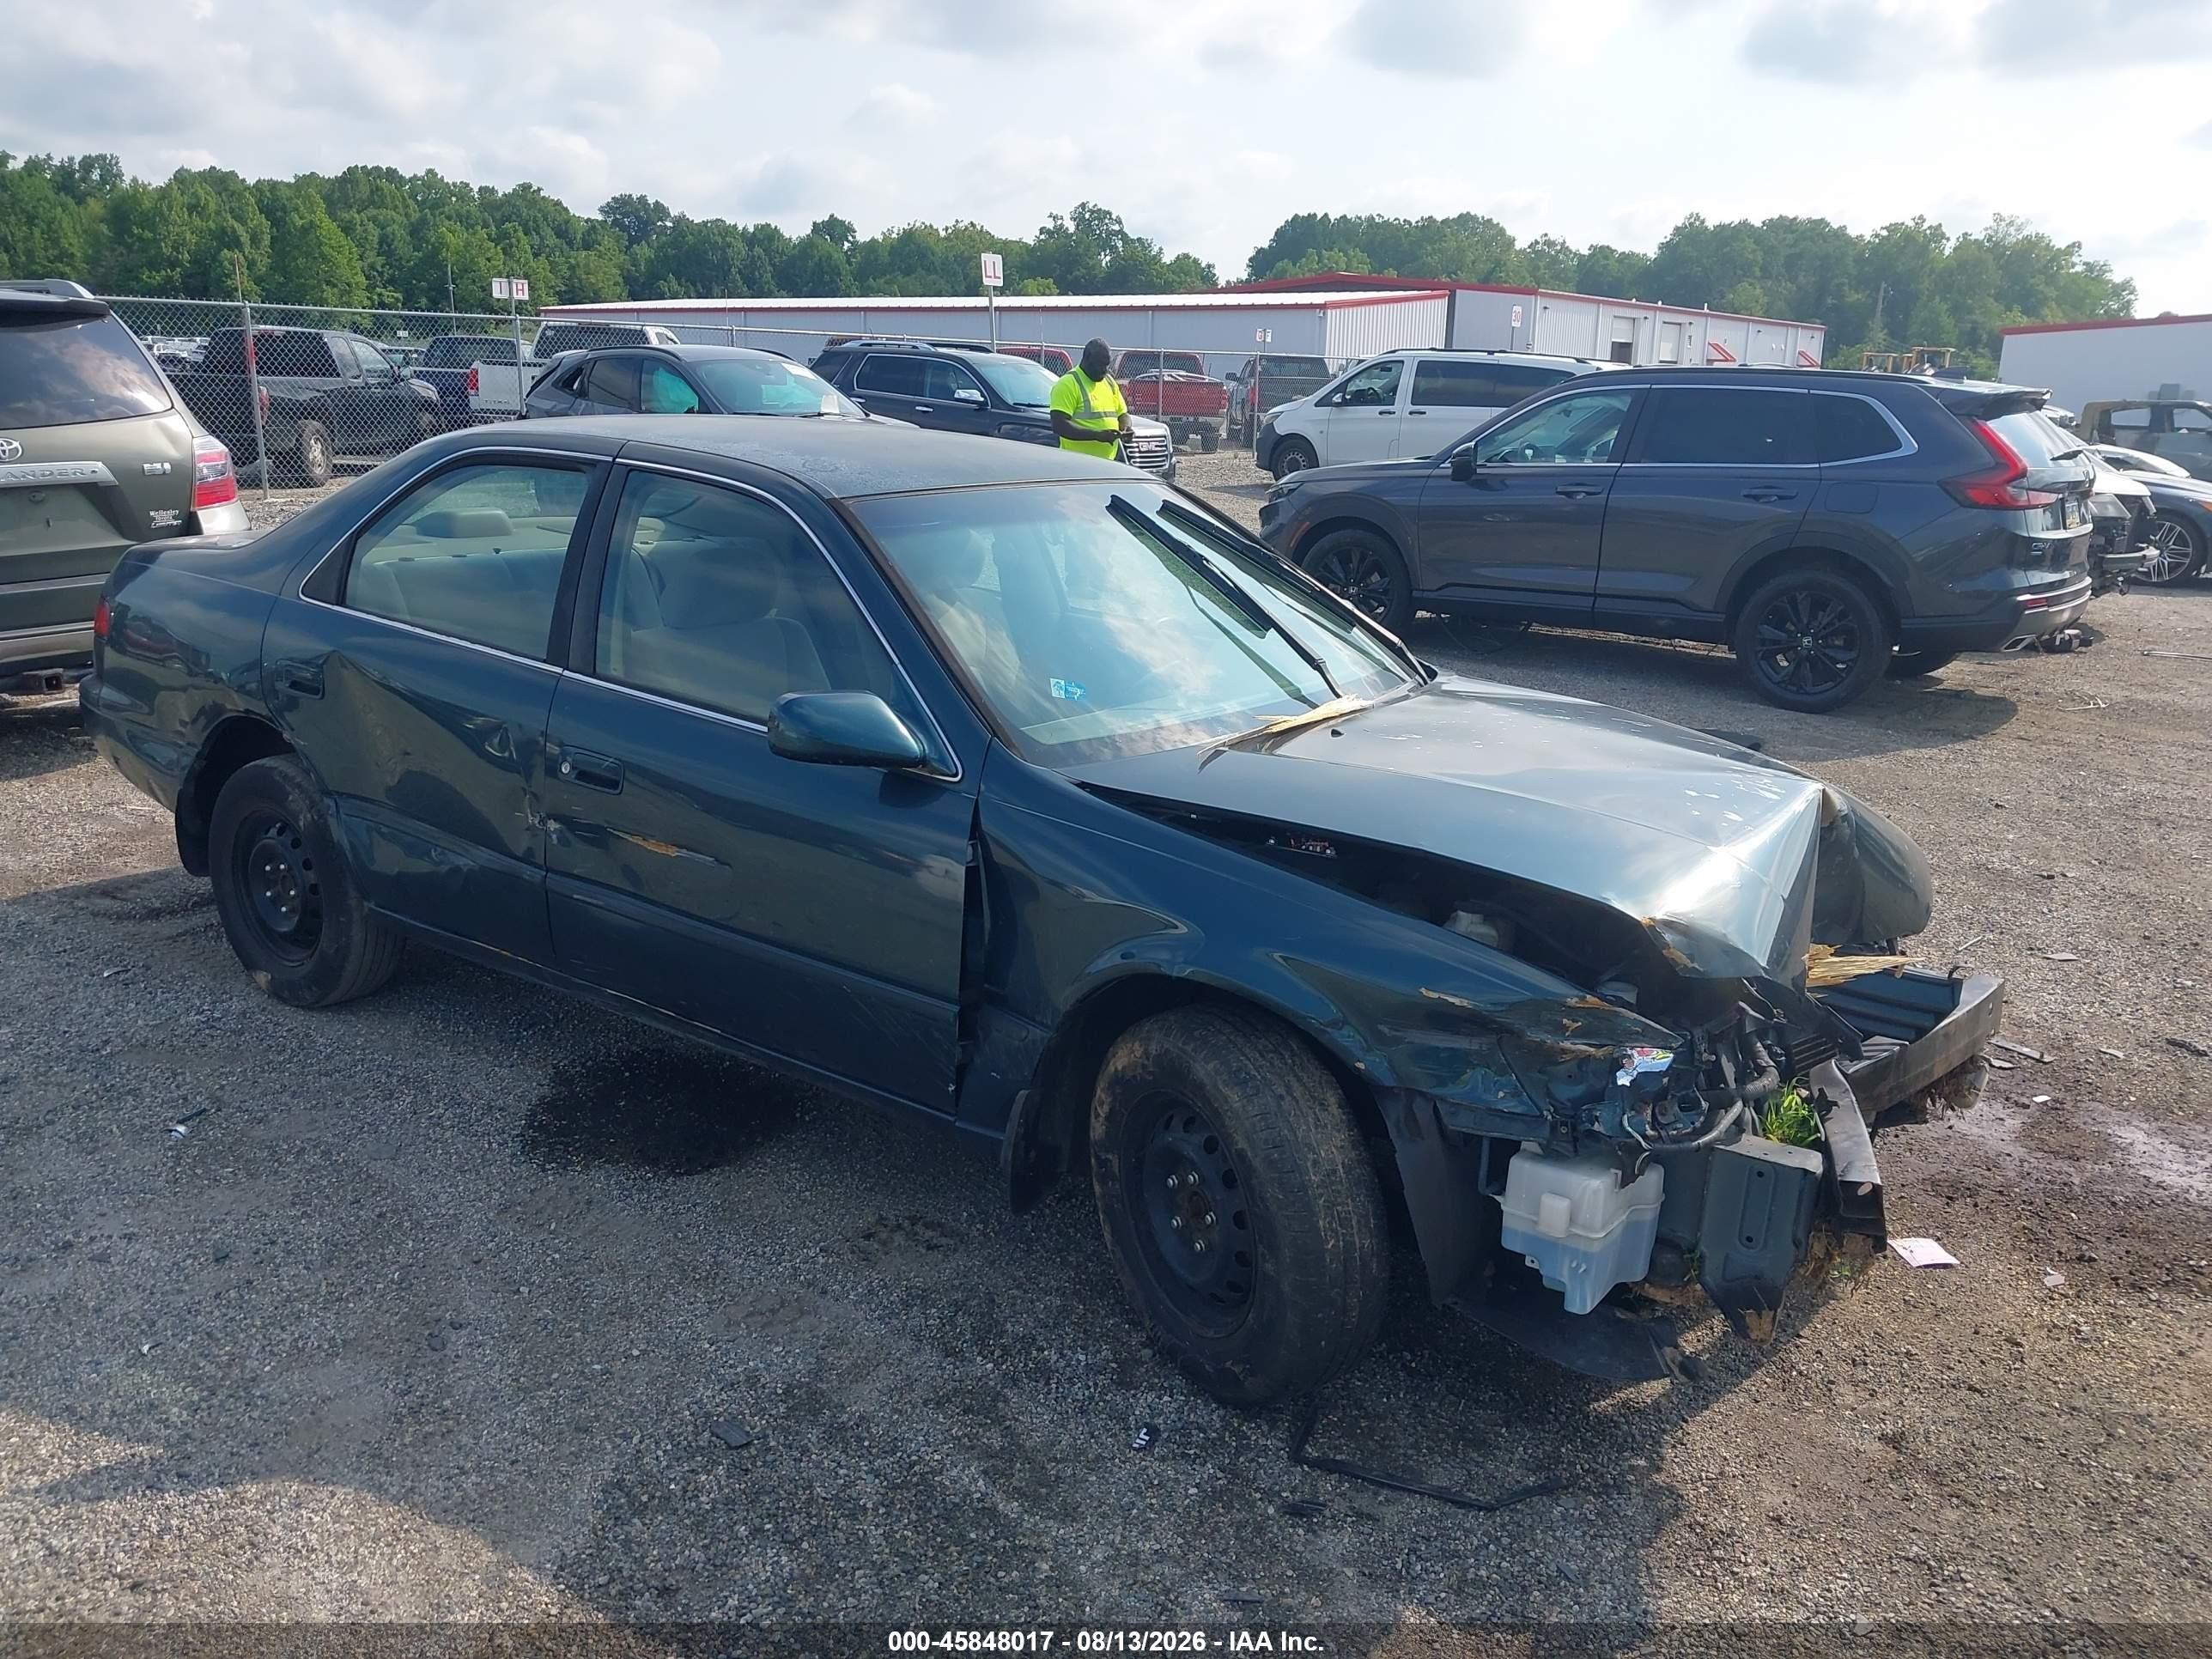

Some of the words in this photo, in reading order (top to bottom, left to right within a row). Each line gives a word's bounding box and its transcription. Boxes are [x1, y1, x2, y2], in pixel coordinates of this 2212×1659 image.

[983, 259, 1001, 279] LL
[515, 283, 525, 296] H
[1512, 310, 1521, 322] 30
[1139, 441, 1160, 452] GMC
